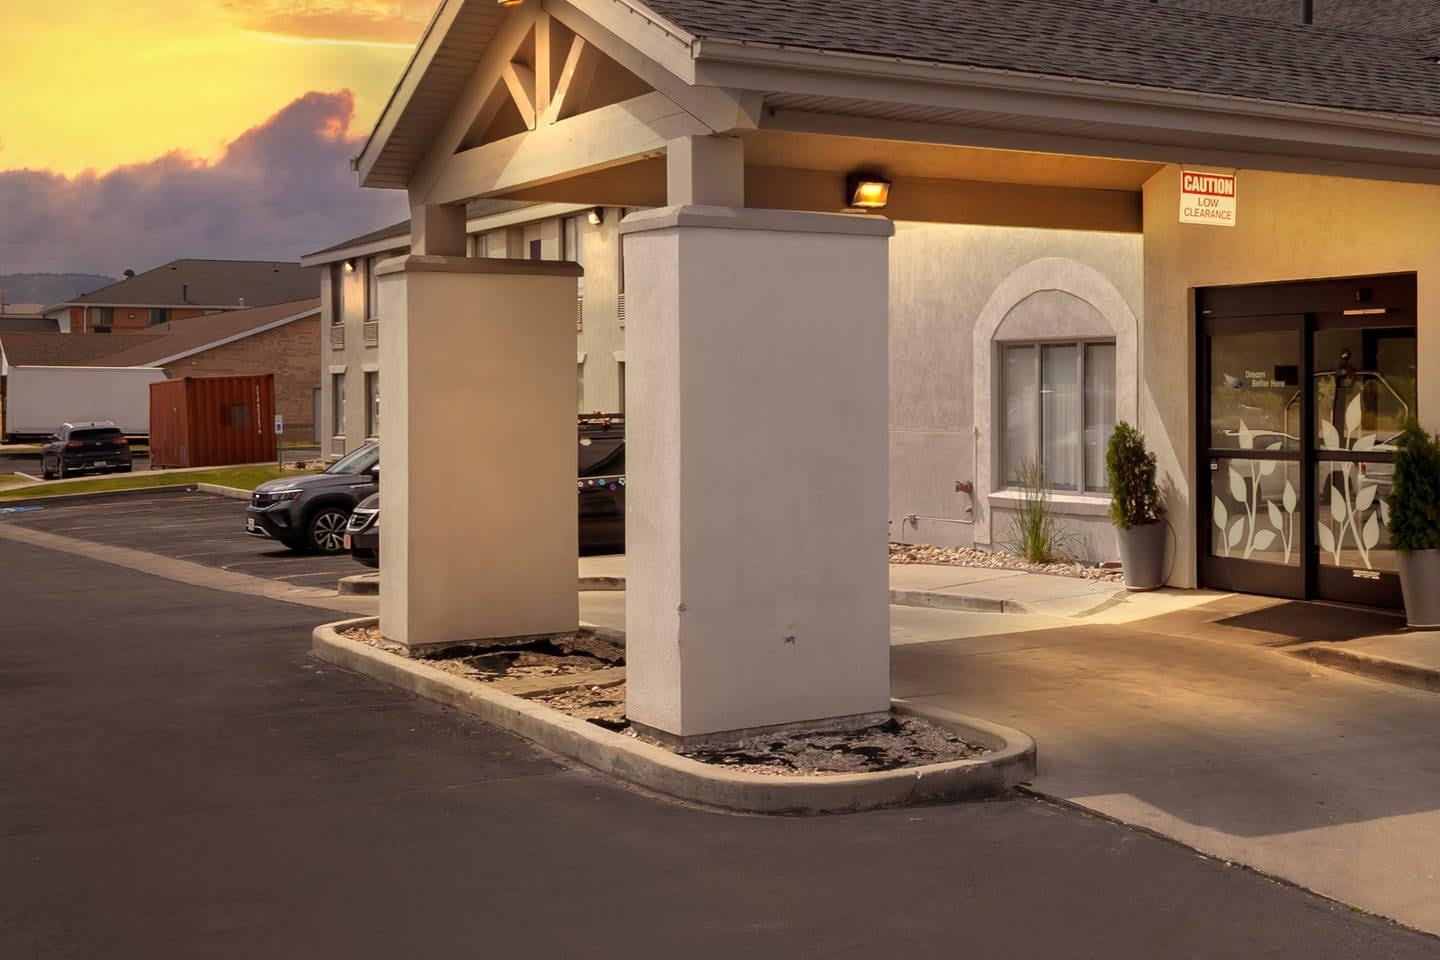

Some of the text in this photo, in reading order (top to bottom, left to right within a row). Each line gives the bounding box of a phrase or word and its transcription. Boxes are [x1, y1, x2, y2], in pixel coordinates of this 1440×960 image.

[1184, 175, 1233, 195] CAUTION
[1198, 197, 1219, 208] LOW
[1184, 207, 1232, 220] CLEARANCE
[1245, 370, 1266, 378] Dream
